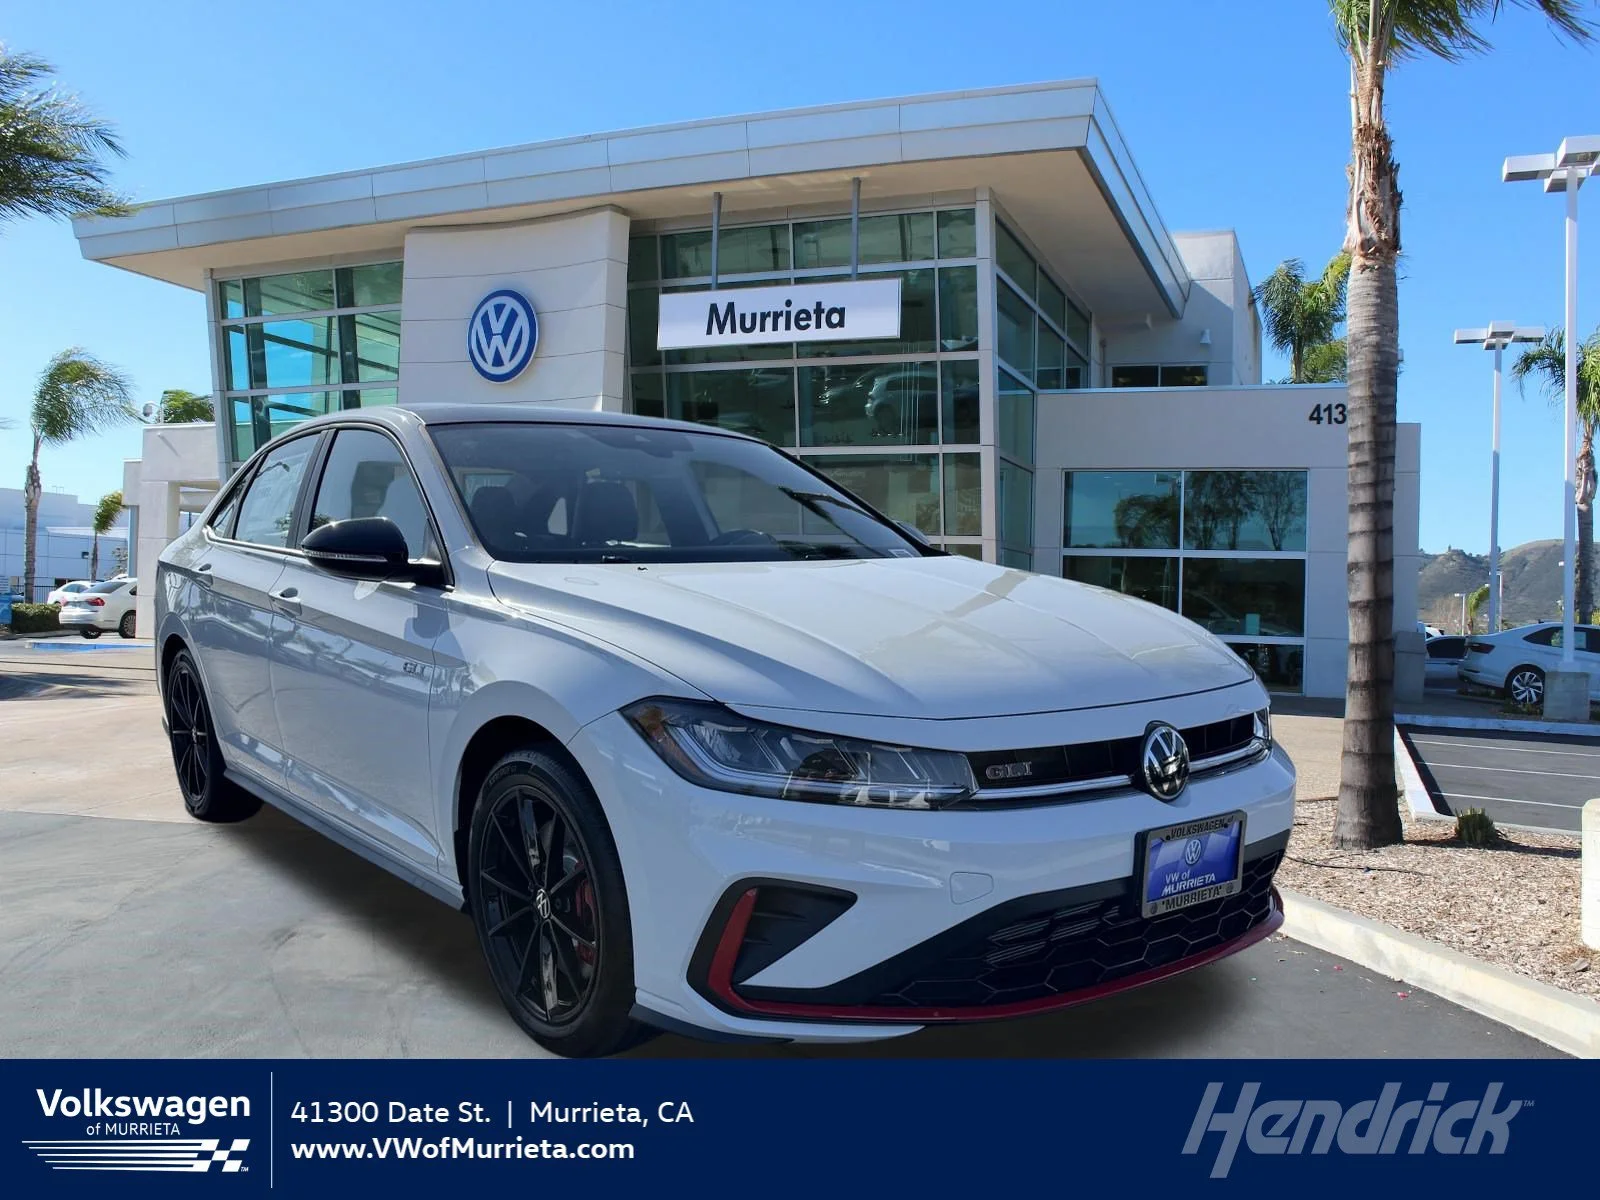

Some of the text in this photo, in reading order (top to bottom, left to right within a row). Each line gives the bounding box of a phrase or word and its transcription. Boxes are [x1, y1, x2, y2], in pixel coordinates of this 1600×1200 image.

[706, 298, 846, 336] Murrieta
[1309, 403, 1347, 425] 413
[1170, 820, 1225, 839] VOLKSWAGEN
[1161, 872, 1216, 897] MURRIETA
[1165, 870, 1191, 885] VW of
